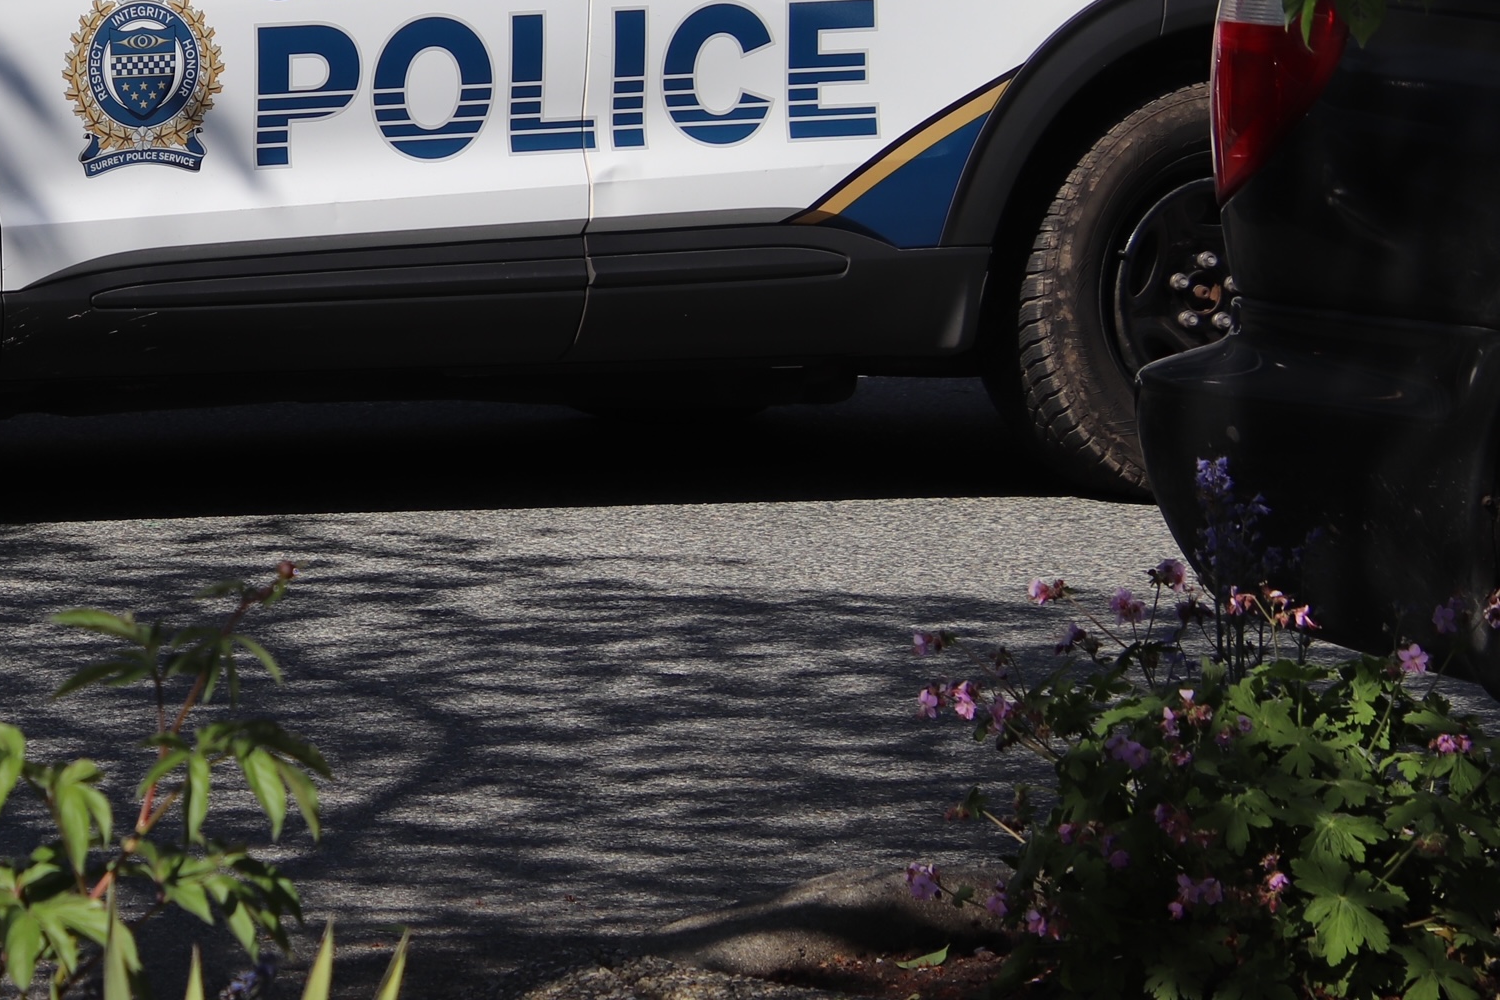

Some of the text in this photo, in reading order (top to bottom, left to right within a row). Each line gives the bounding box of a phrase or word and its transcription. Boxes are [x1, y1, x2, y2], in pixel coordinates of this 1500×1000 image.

[111, 6, 174, 27] INTEGRITY
[89, 40, 108, 101] RESPECT
[178, 38, 196, 98] HONOUR
[90, 151, 196, 173] SURREY POLICE SERVICE
